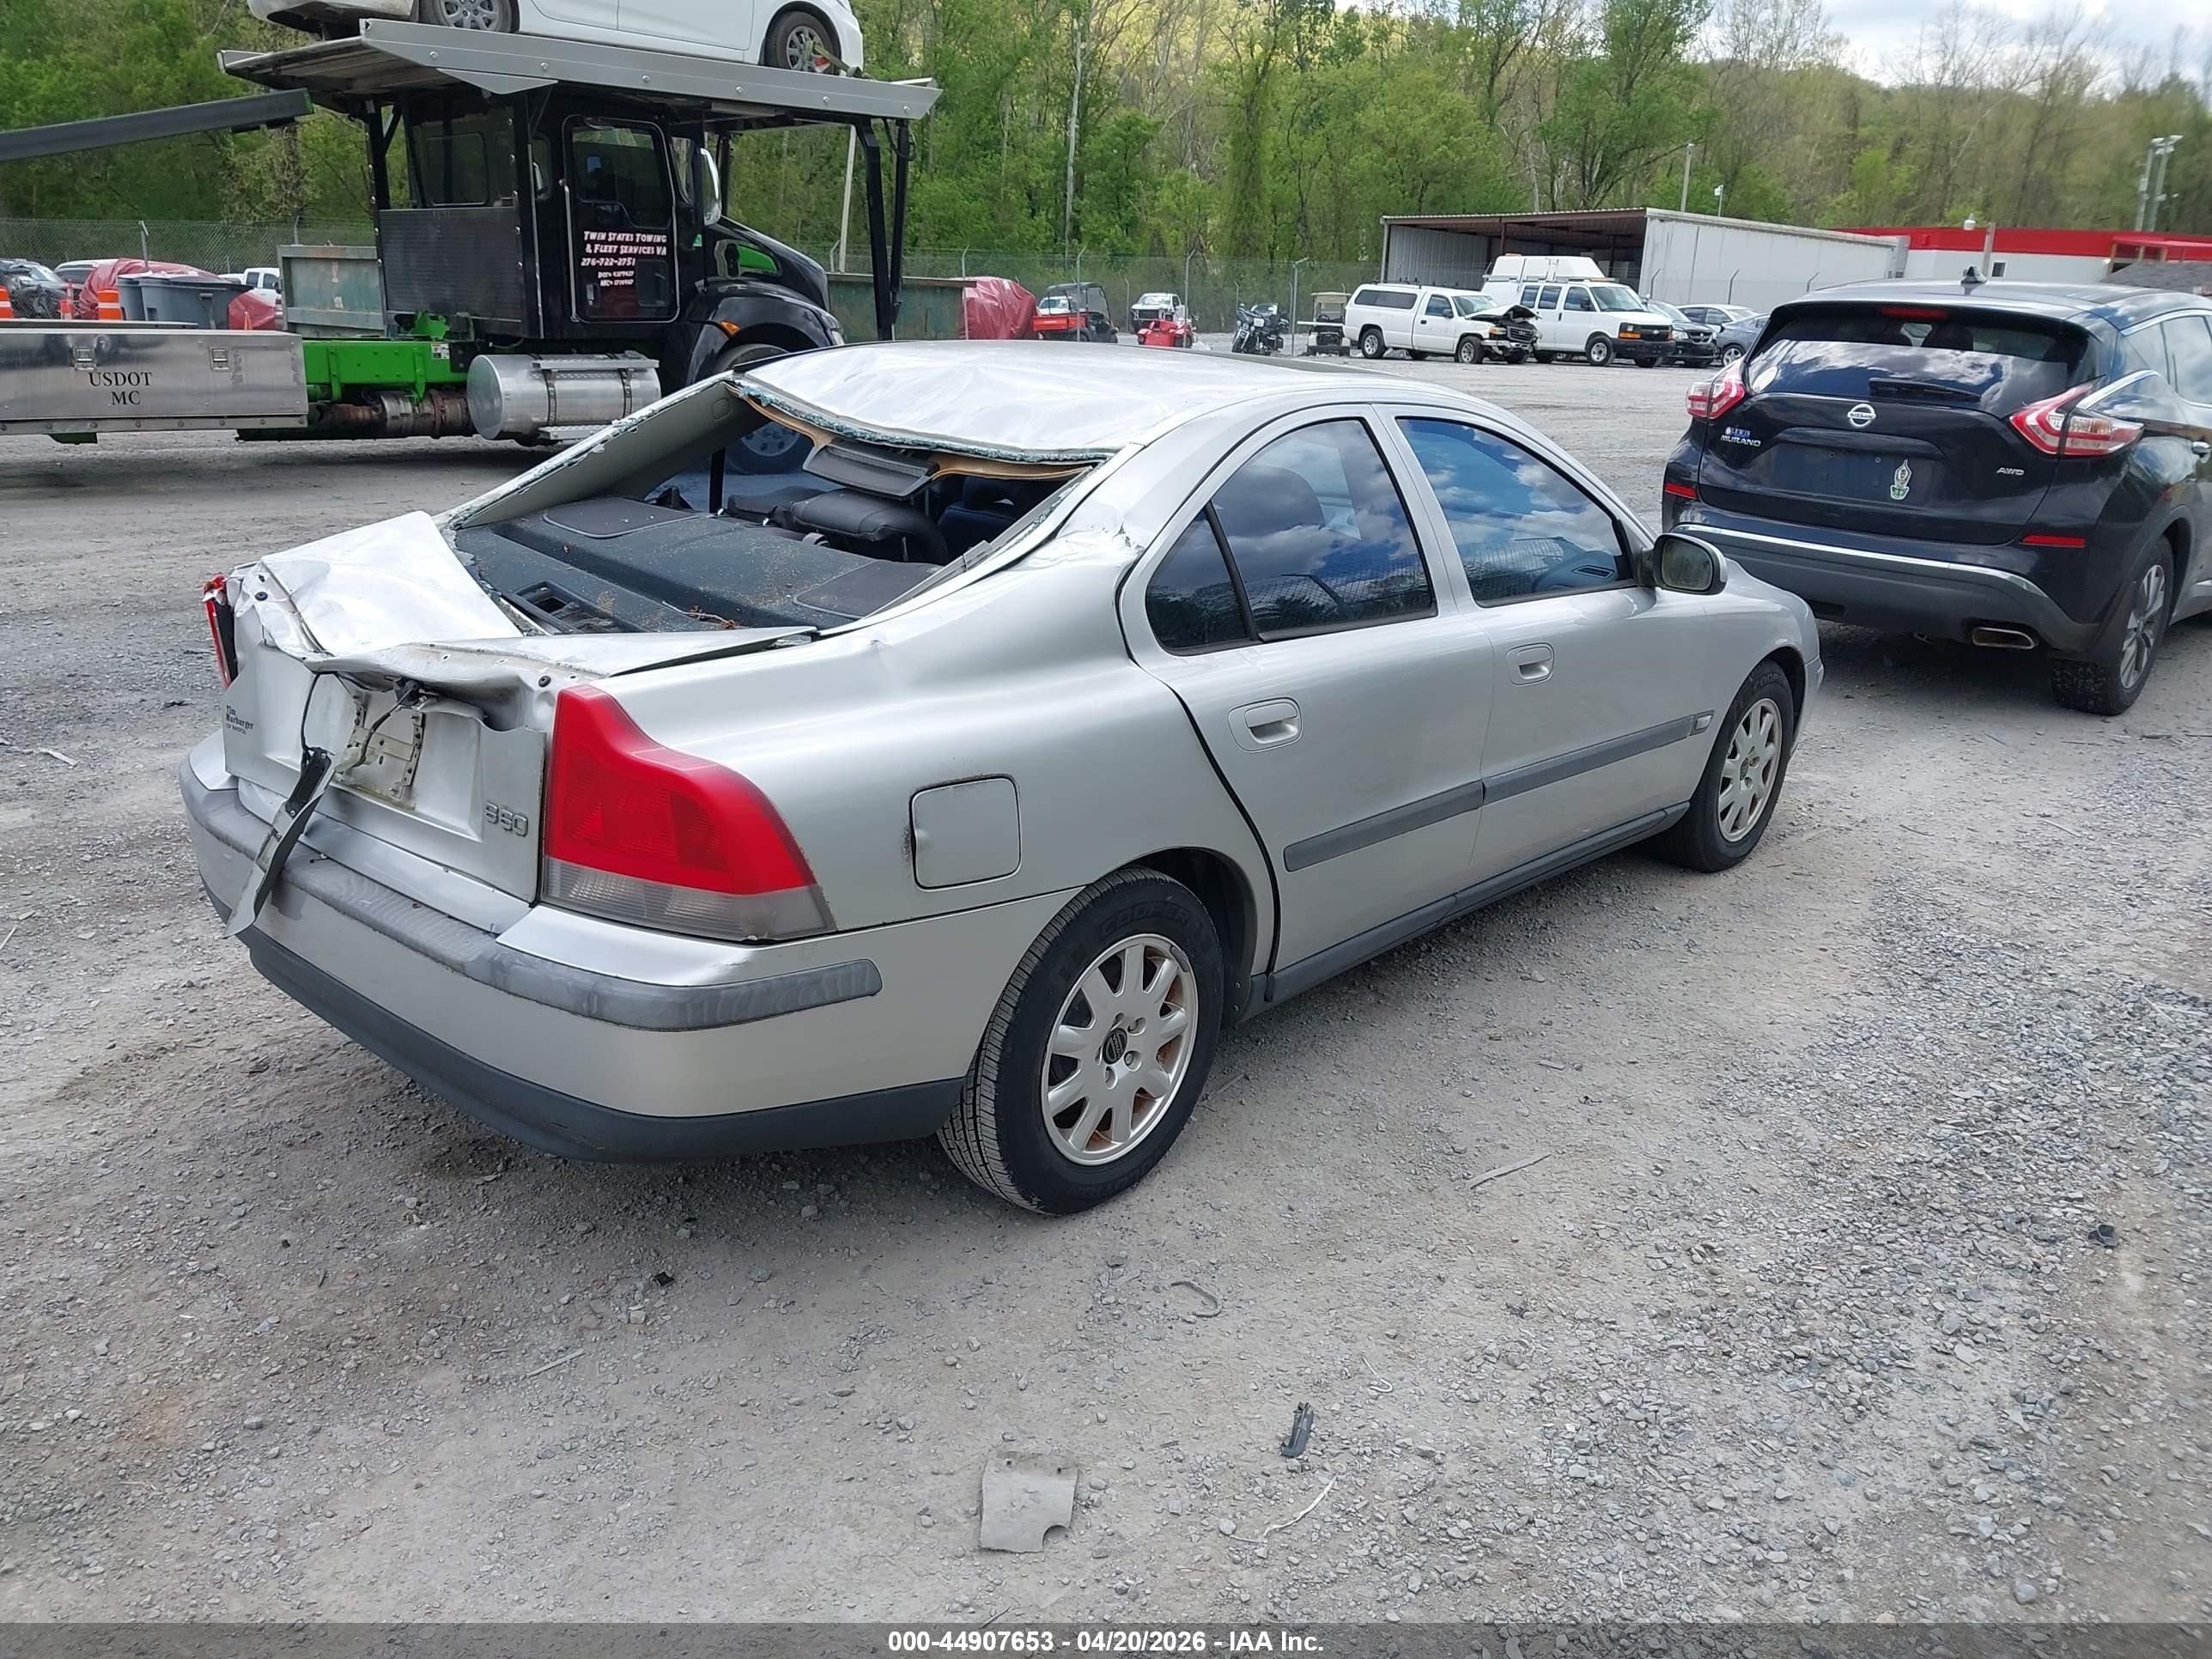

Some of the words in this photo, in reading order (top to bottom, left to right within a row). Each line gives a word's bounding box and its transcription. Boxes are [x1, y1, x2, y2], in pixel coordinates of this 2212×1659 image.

[584, 231, 606, 240] TWIN
[607, 232, 634, 241] STATES
[635, 233, 667, 243] TOWING
[586, 243, 592, 253] &
[593, 244, 618, 253] FLEET
[619, 245, 655, 255] SERVICES
[656, 246, 667, 256] VA
[580, 258, 636, 267] 276-722-2751
[88, 371, 152, 386] USDOT
[111, 390, 142, 405] MC
[1731, 428, 1752, 438] LEWIS
[1720, 434, 1761, 447] MURANO
[1996, 467, 2025, 476] AWD
[226, 705, 236, 716] Tim
